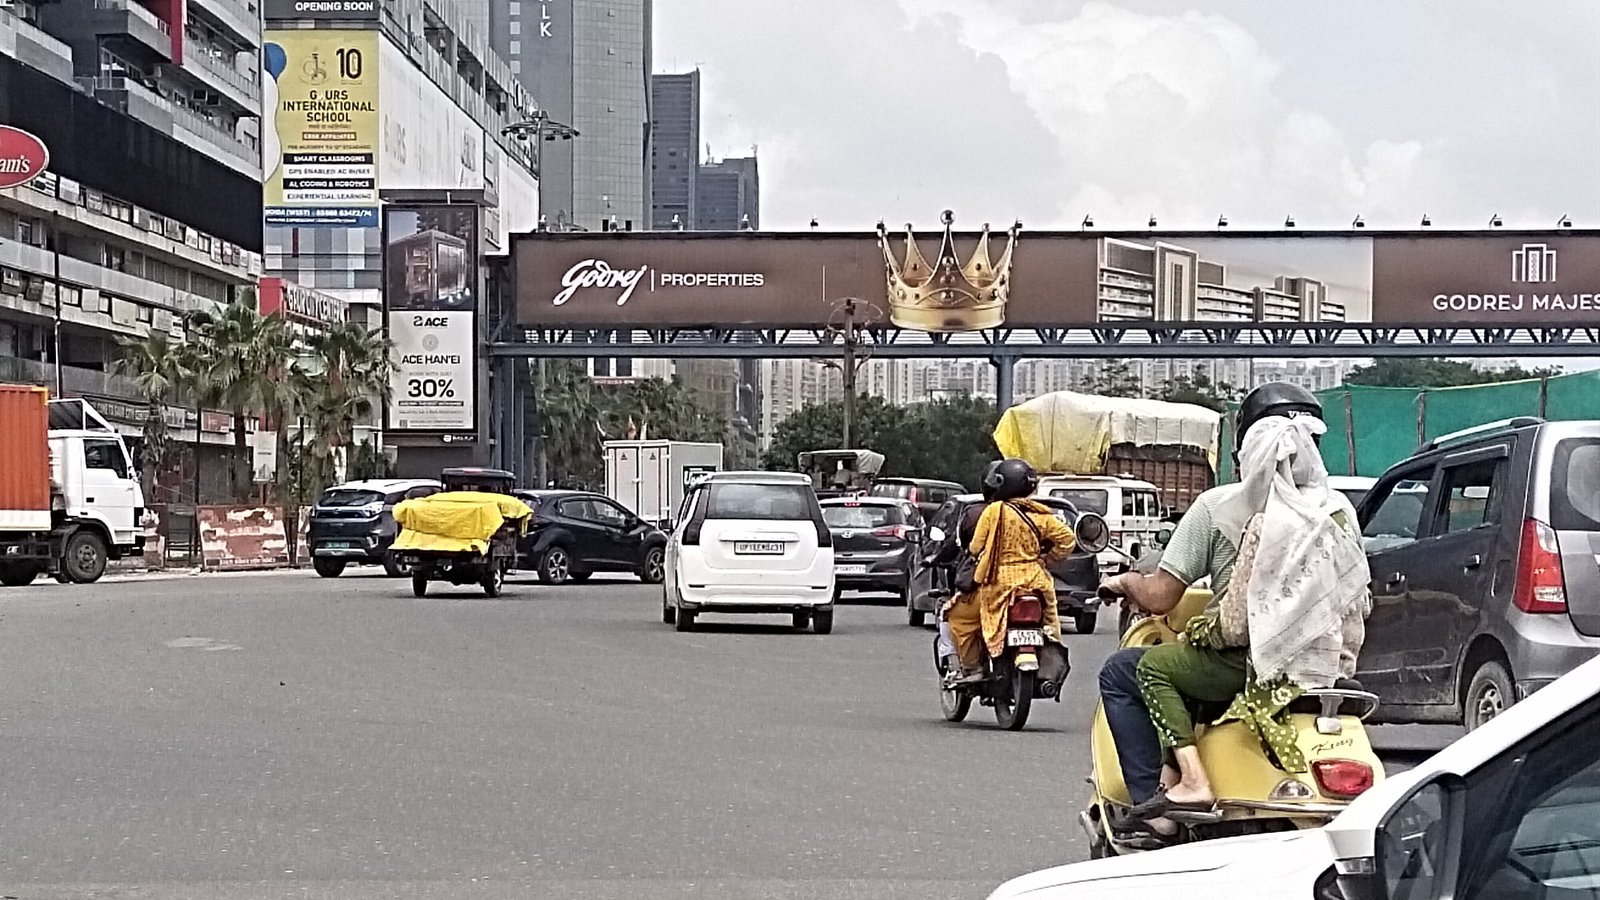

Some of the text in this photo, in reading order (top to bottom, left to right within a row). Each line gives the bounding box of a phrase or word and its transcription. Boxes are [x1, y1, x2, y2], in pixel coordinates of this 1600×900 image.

[295, 2, 374, 11] OPENING SOON
[336, 48, 363, 79] 10
[309, 90, 349, 100] GURS
[283, 101, 375, 112] INTERNATIONAL
[306, 112, 352, 122] SCHOOL
[299, 180, 328, 188] CODING
[334, 180, 370, 188] ROBOTICS
[553, 259, 765, 306] Godrej PROPERTIES
[1432, 294, 1524, 311] GODREJ
[424, 317, 449, 327] ACE
[401, 355, 461, 364] ACE HAN'EI
[408, 379, 454, 398] 30%
